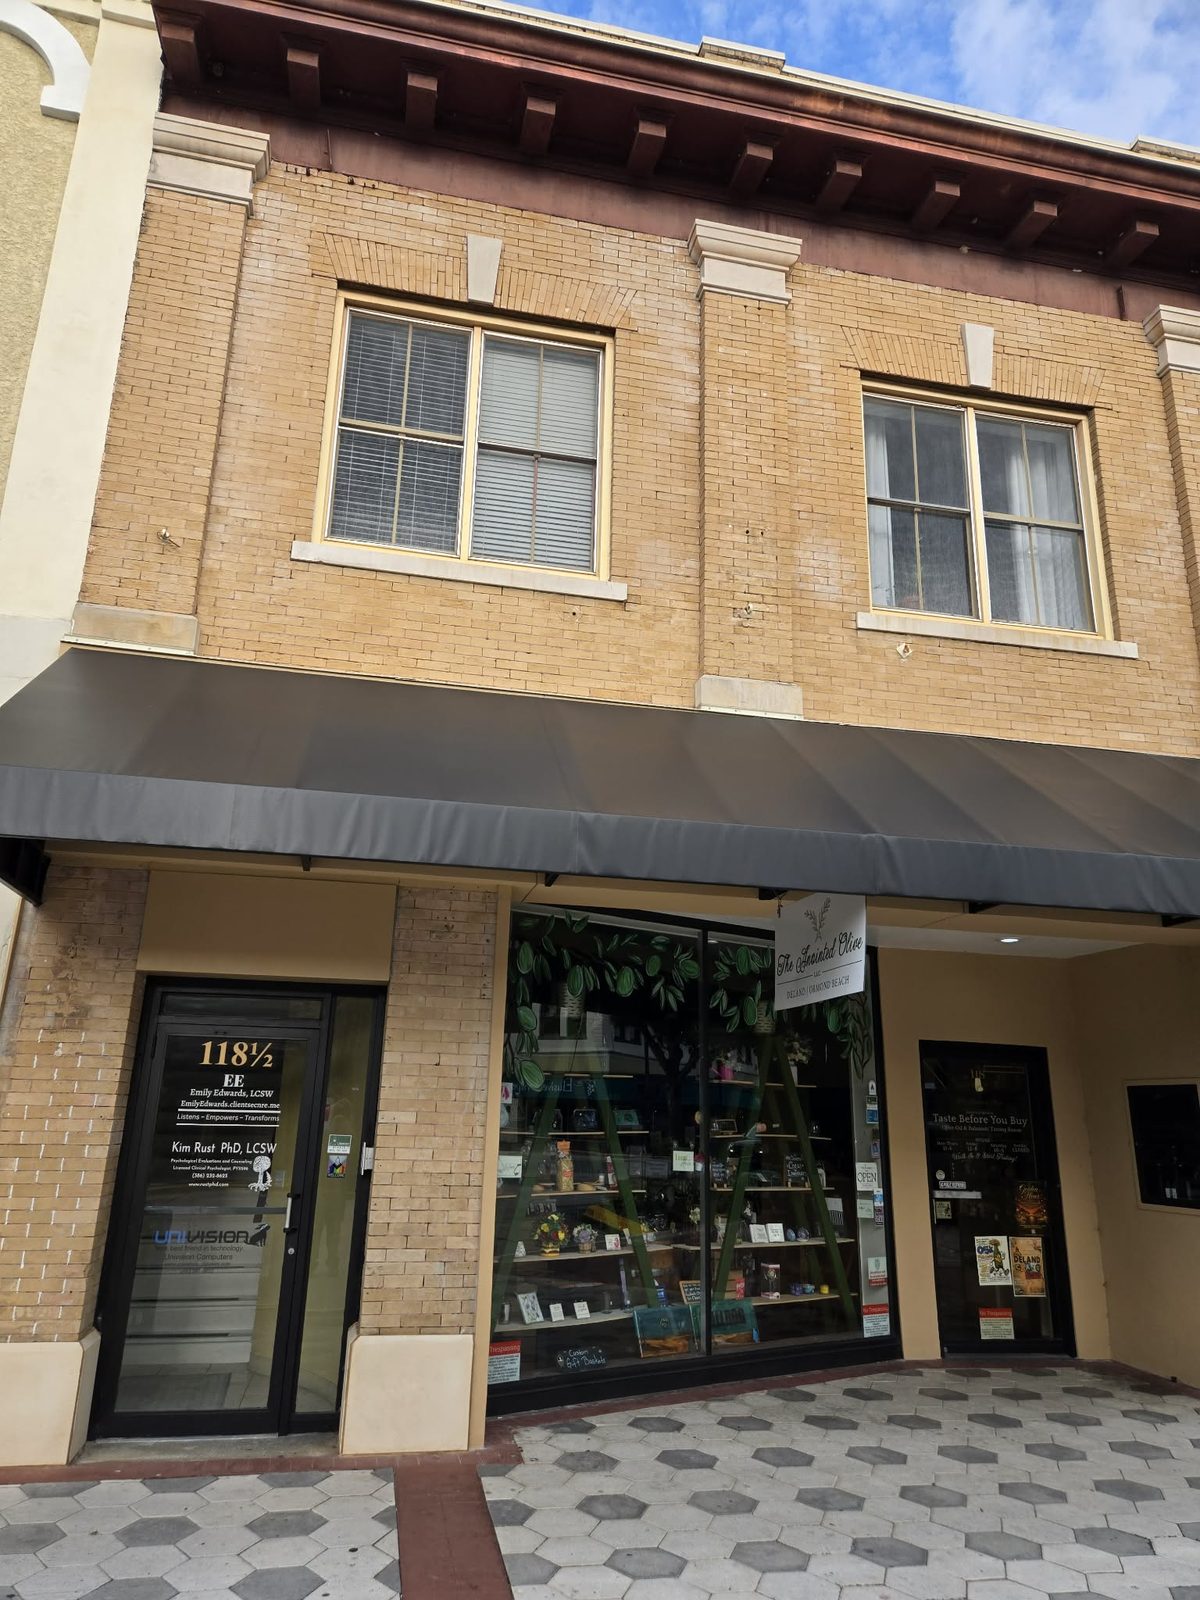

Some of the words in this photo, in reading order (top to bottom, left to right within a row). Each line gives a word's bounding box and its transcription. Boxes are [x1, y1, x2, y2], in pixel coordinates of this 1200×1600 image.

[776, 954, 793, 977] The
[795, 937, 837, 974] Anointed
[838, 931, 863, 957] Olive
[831, 975, 850, 988] BEACH
[223, 1074, 245, 1088] EE
[190, 1088, 212, 1098] Emily
[213, 1089, 248, 1098] Edwards,
[250, 1090, 274, 1098] LCSW
[245, 1114, 280, 1122] Transforms
[932, 1113, 957, 1123] Taste
[959, 1114, 988, 1124] Before
[990, 1115, 1008, 1125] You
[1010, 1116, 1027, 1128] Buy
[171, 1141, 191, 1153] Kim
[194, 1142, 216, 1153] Rust
[220, 1142, 243, 1155] PhD,
[246, 1142, 277, 1154] LCSW
[857, 1171, 877, 1184] OPEN
[1013, 1256, 1041, 1264] DELAND
